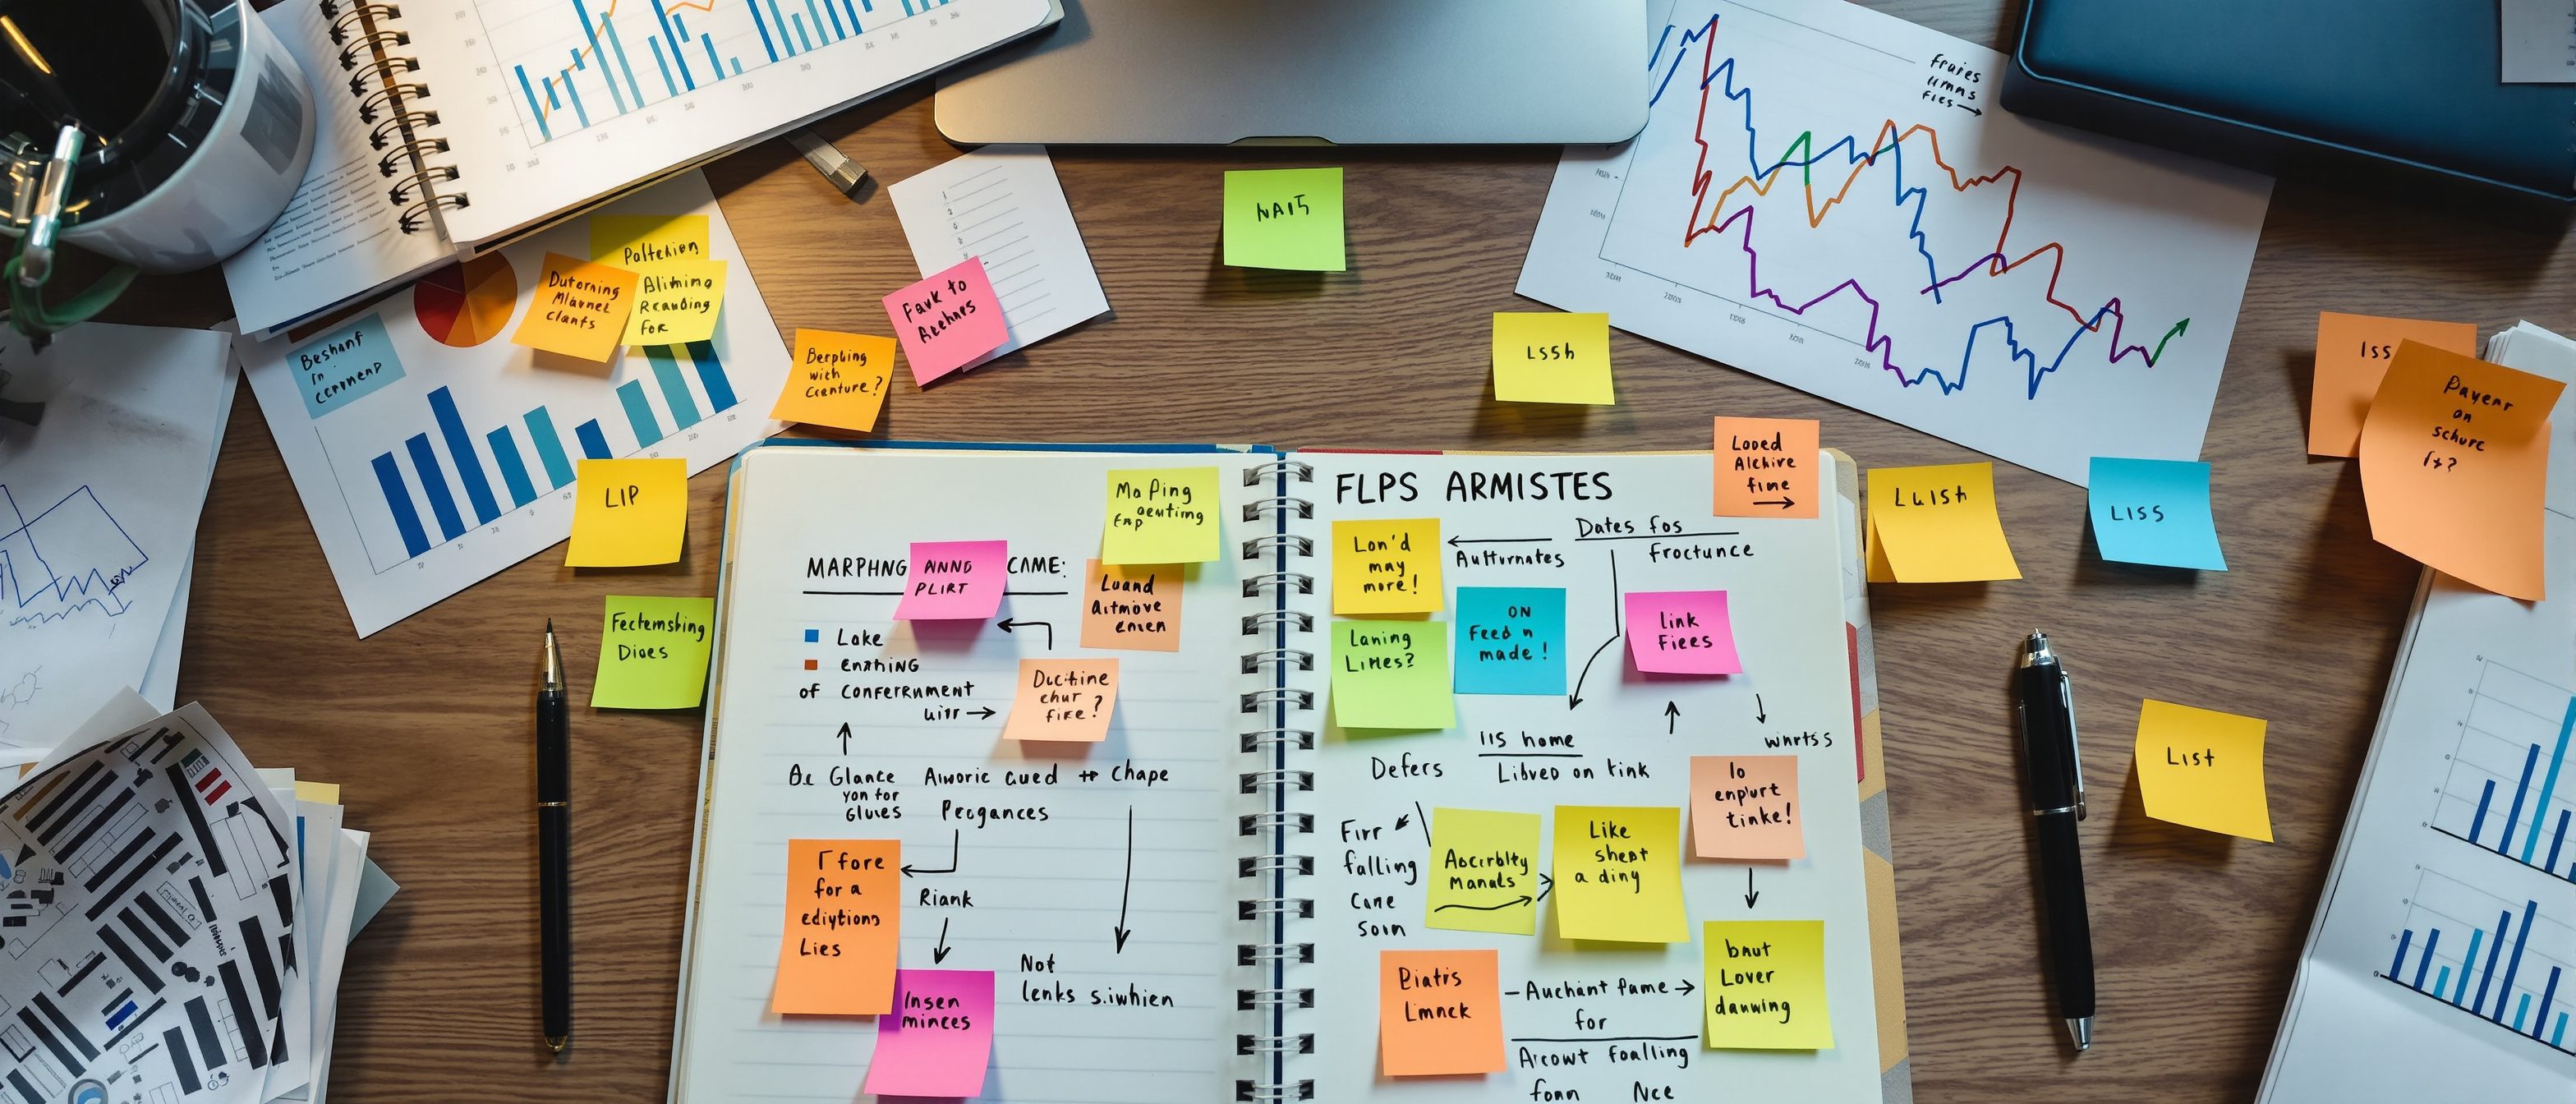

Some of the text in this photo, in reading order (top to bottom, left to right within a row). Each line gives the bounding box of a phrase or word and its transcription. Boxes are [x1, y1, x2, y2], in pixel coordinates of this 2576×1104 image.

[947, 279, 967, 296] to
[1336, 470, 1612, 505] FLPS ARMISTES
[1575, 517, 1635, 538] Dates
[1521, 730, 1575, 748] home
[1573, 767, 1594, 780] on
[814, 876, 843, 899] for
[1021, 953, 1056, 974] Not
[1575, 1008, 1608, 1031] for
